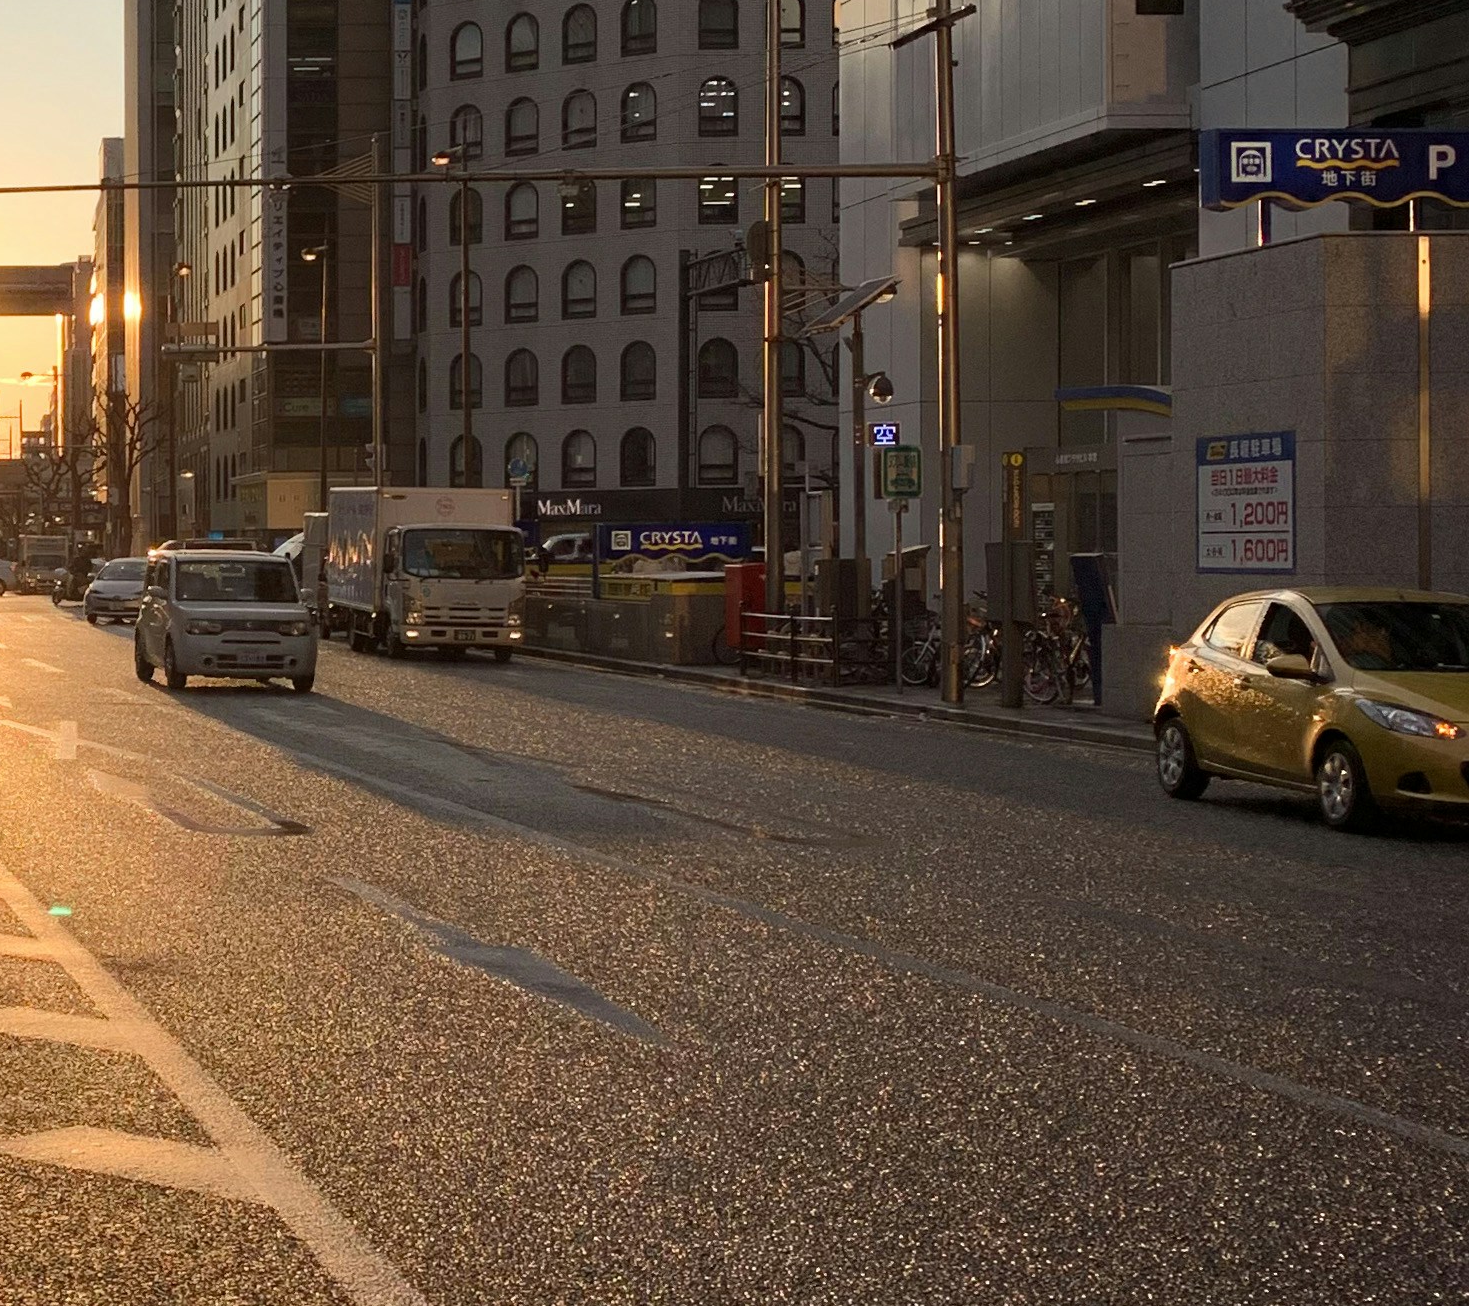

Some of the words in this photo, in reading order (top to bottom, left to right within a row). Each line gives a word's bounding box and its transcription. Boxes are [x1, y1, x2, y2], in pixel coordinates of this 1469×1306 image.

[1295, 139, 1401, 159] CRYSTA
[1428, 144, 1456, 181] P
[1321, 170, 1378, 186] 地下街
[873, 424, 897, 445] 空
[538, 499, 602, 516] MaxMara
[722, 496, 798, 513] Maxra
[1231, 501, 1289, 529] 1,200円
[639, 530, 702, 545] CRYSTA
[1231, 538, 1289, 566] 1,600円
